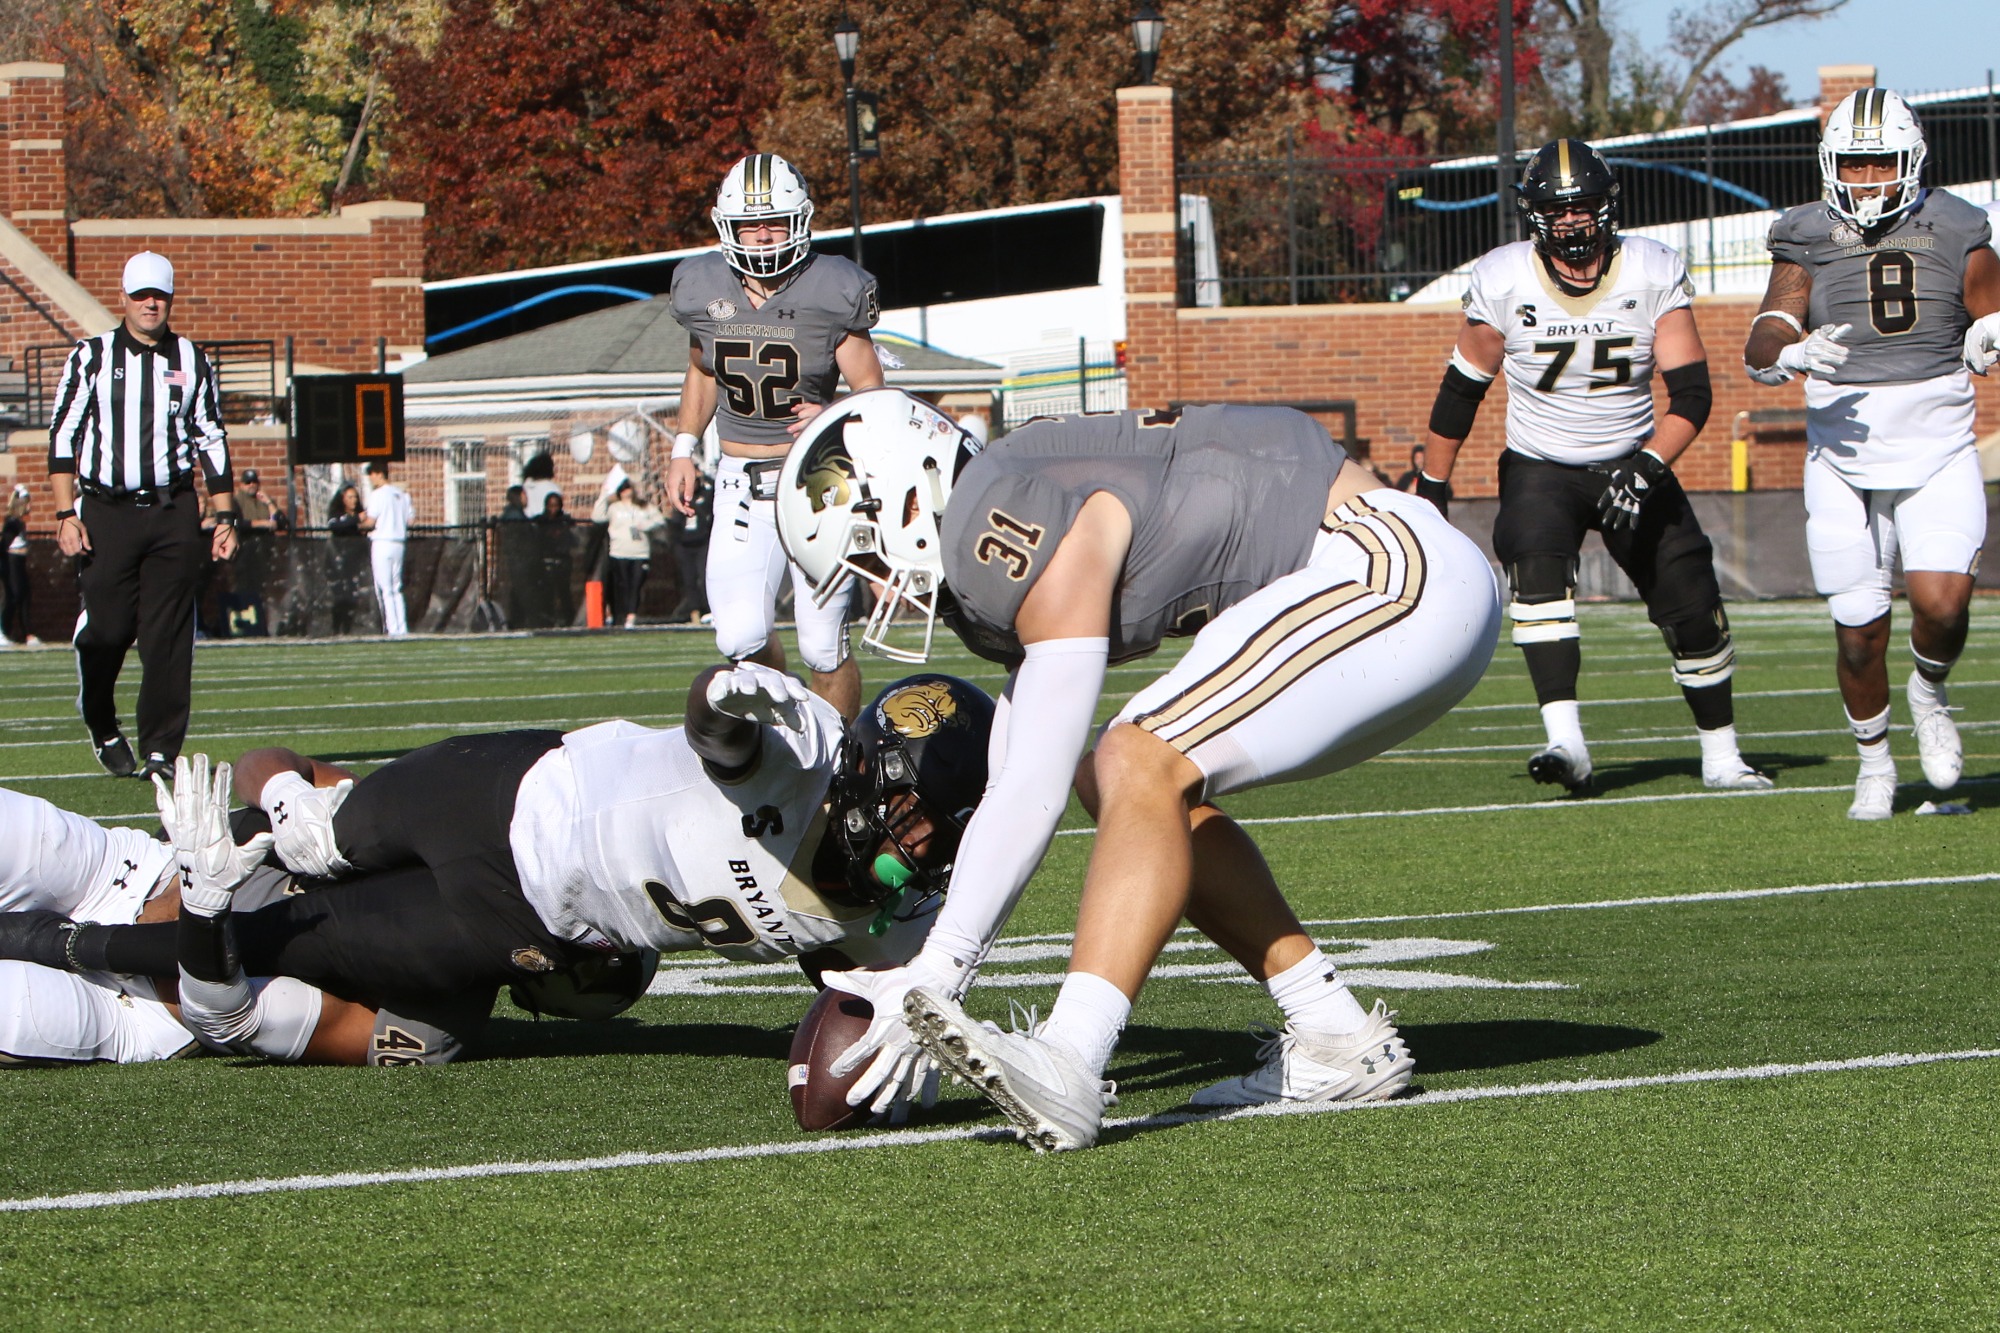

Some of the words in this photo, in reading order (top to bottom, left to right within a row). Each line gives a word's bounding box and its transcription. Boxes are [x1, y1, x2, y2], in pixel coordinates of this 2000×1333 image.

[1866, 249, 1919, 336] 8
[716, 323, 796, 339] LINDENWOOD
[1547, 321, 1615, 337] BRYANT
[114, 367, 125, 380] S
[713, 339, 804, 421] 52
[1533, 335, 1638, 393] 75
[355, 383, 393, 456] 0
[974, 508, 1046, 582] 31
[741, 804, 784, 838] S
[728, 859, 796, 945] BRYANT
